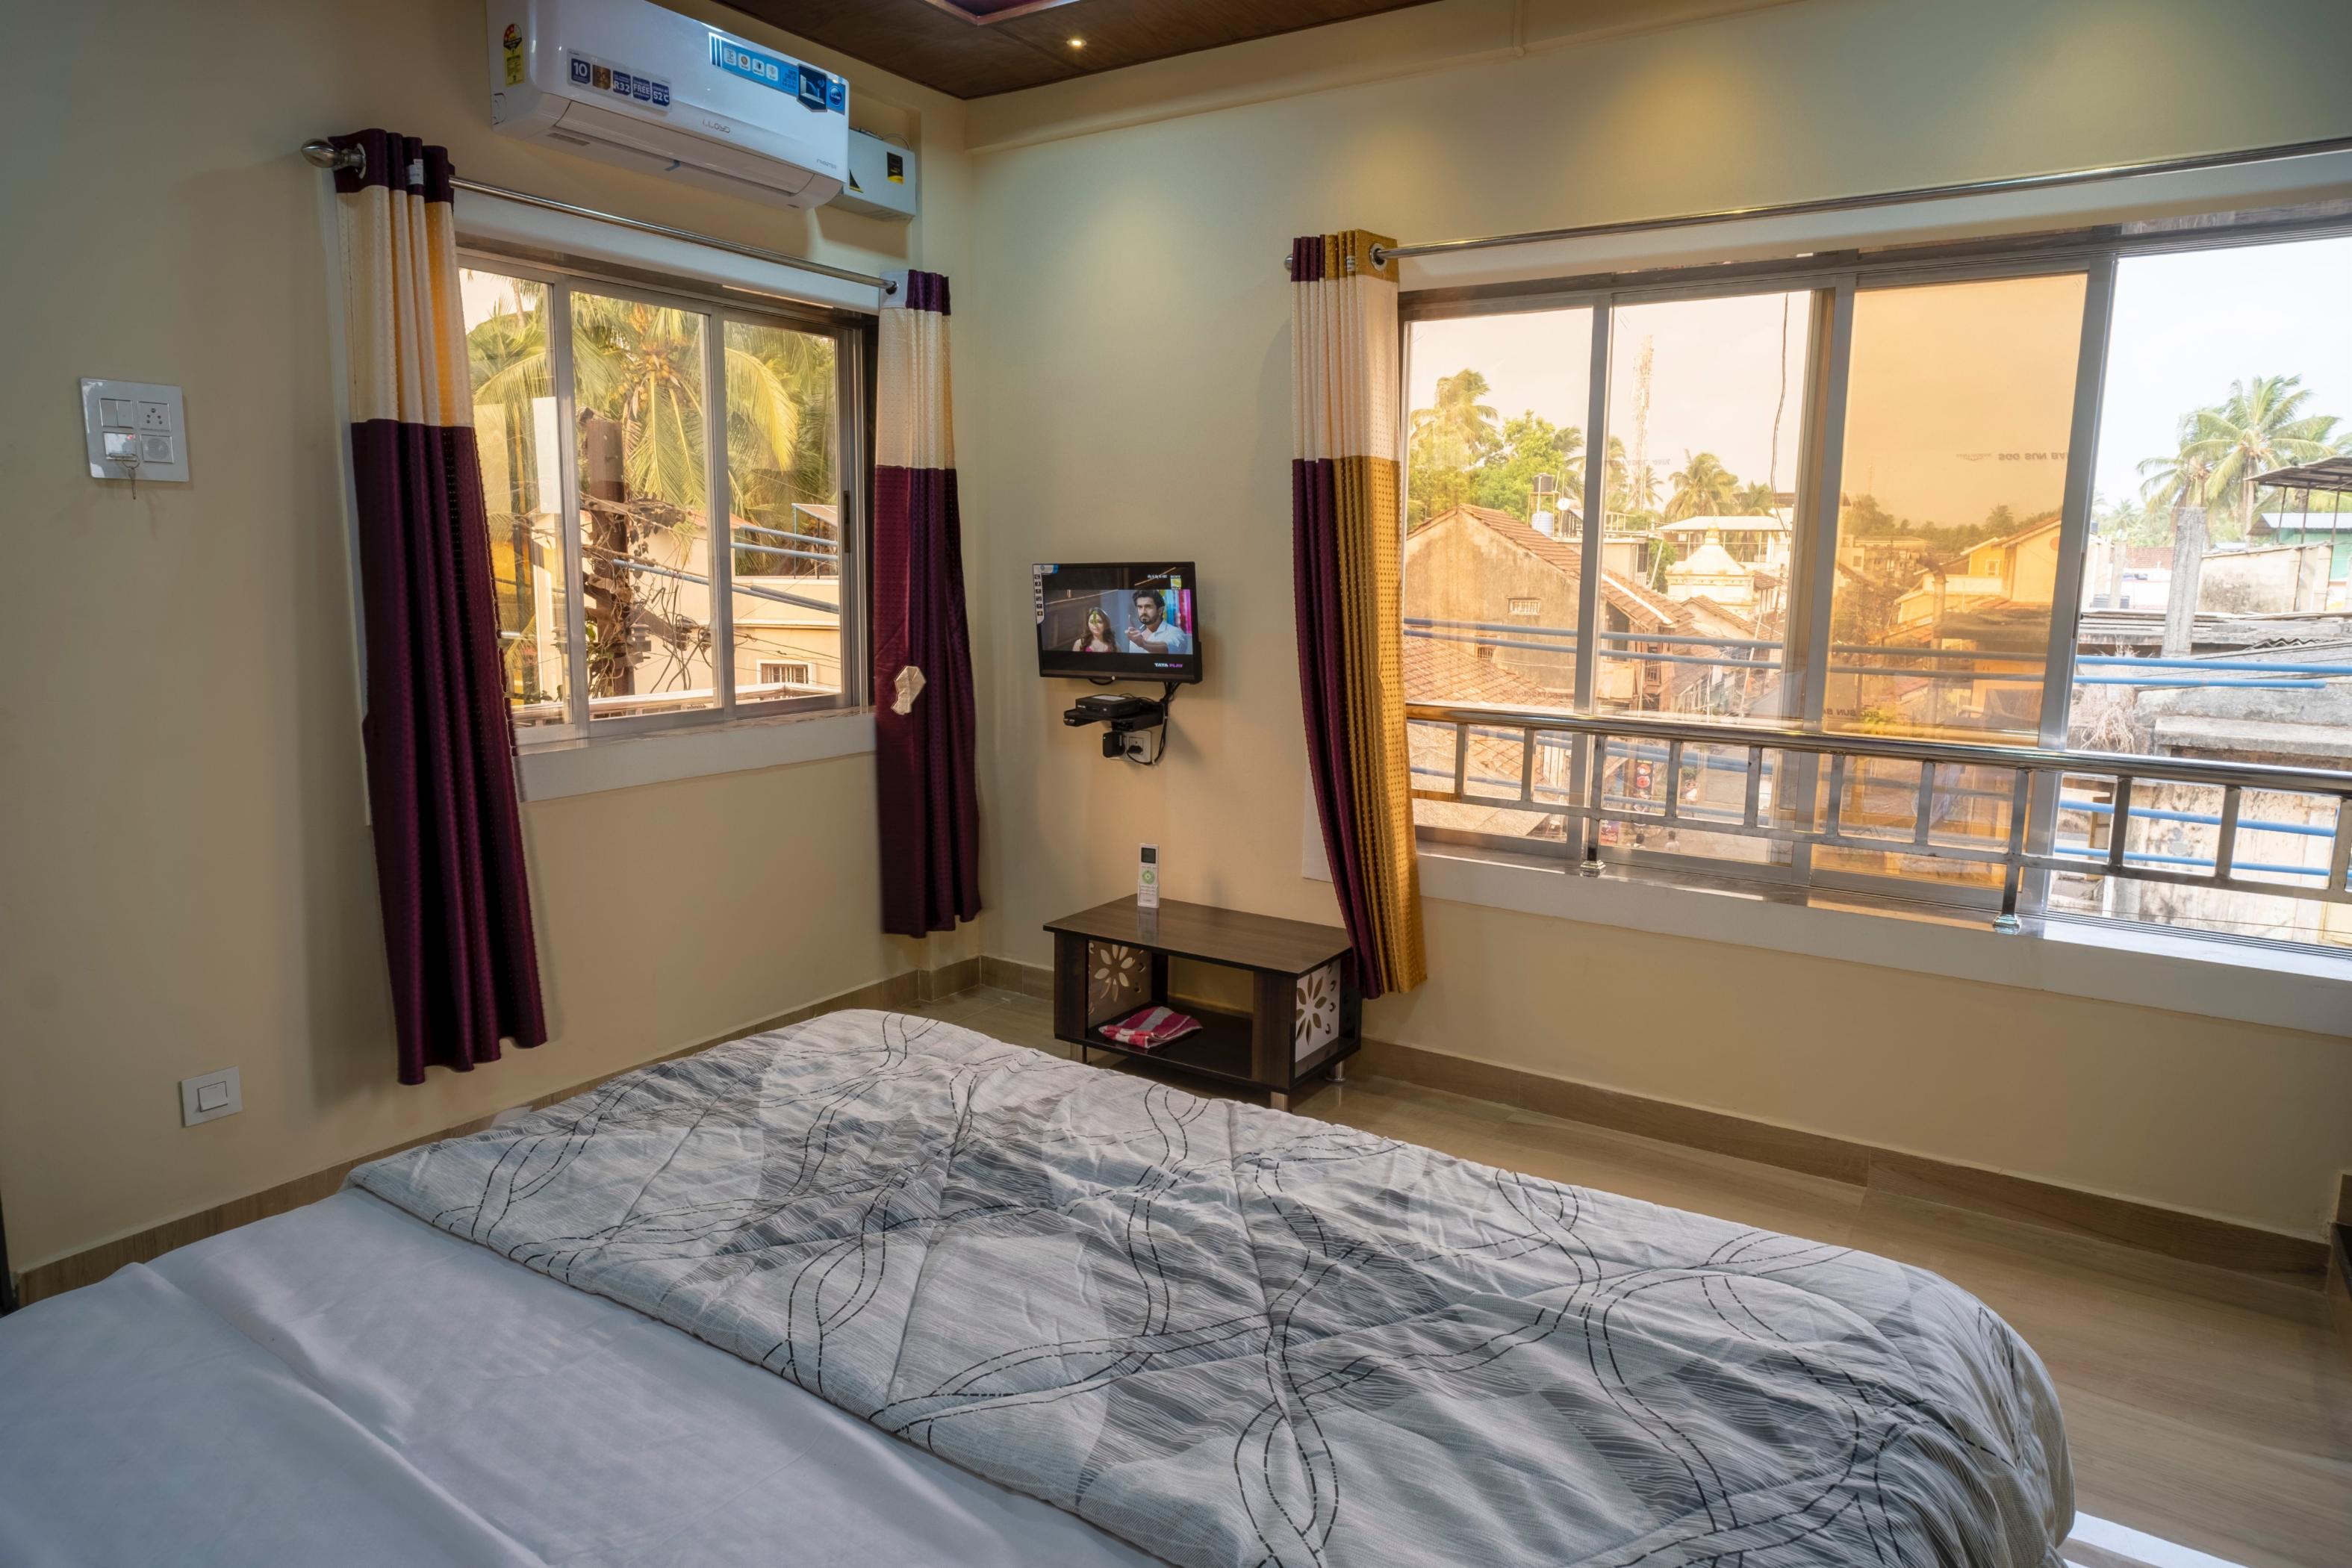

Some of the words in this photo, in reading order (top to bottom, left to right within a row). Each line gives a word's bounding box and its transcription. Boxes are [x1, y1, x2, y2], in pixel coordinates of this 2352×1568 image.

[573, 62, 588, 77] 10
[614, 80, 630, 93] R32
[633, 83, 650, 95] FREE
[702, 119, 730, 134] LLOYD
